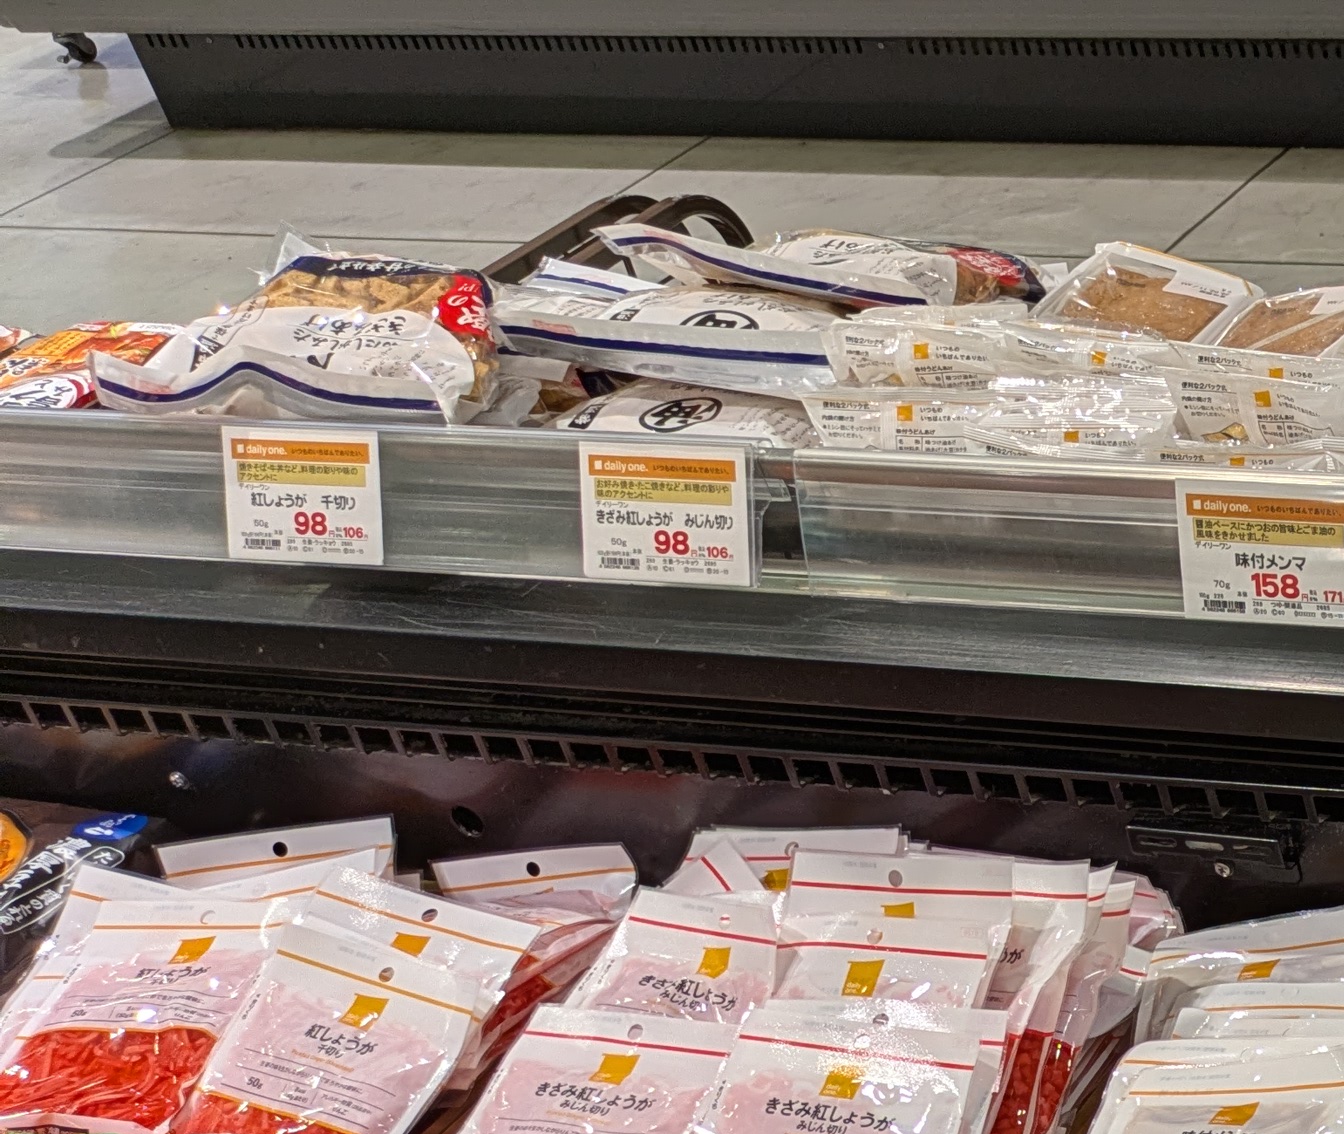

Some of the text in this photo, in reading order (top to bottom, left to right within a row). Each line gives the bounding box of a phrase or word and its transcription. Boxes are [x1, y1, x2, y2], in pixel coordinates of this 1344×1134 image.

[251, 492, 356, 510] 紅しょうが 千切り
[254, 520, 269, 528] 50g
[294, 512, 327, 536] 98
[596, 510, 733, 530] きざみ紅しょうが みじん切り
[611, 538, 627, 547] 50g
[654, 530, 690, 555] 98
[1235, 553, 1306, 571] 味付メンマ
[1214, 580, 1230, 590] 70g
[1251, 573, 1299, 599] 158
[305, 1024, 377, 1056] 紅しょうが
[247, 1077, 263, 1090] 50g
[765, 1098, 896, 1131] きざみ紅しょうが
